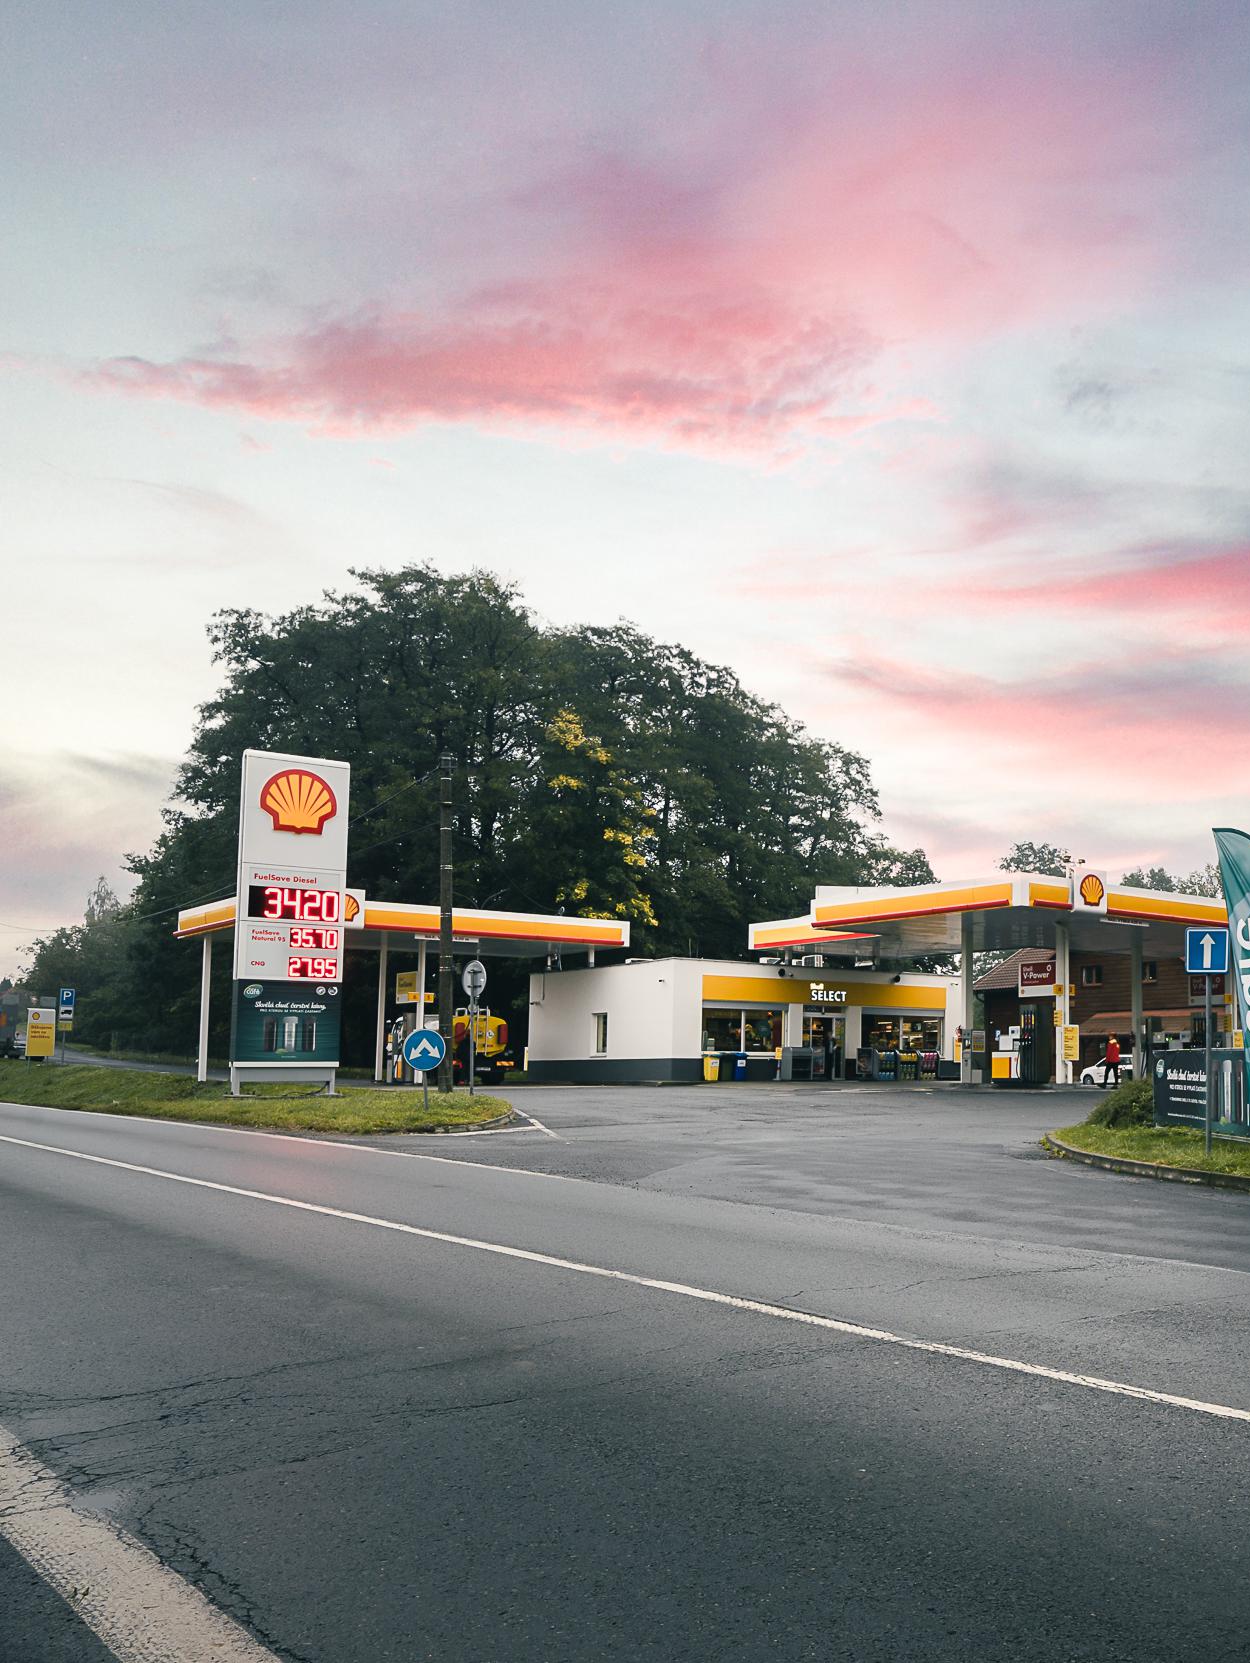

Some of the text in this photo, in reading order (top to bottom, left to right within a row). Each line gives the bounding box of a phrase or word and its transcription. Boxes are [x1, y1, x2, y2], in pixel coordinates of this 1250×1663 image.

[254, 873, 290, 882] FuelSave
[264, 887, 339, 922] 34.20
[290, 928, 338, 948] 35.70
[289, 958, 336, 978] 27.95
[64, 991, 72, 1000] P
[811, 990, 847, 1002] SELECT
